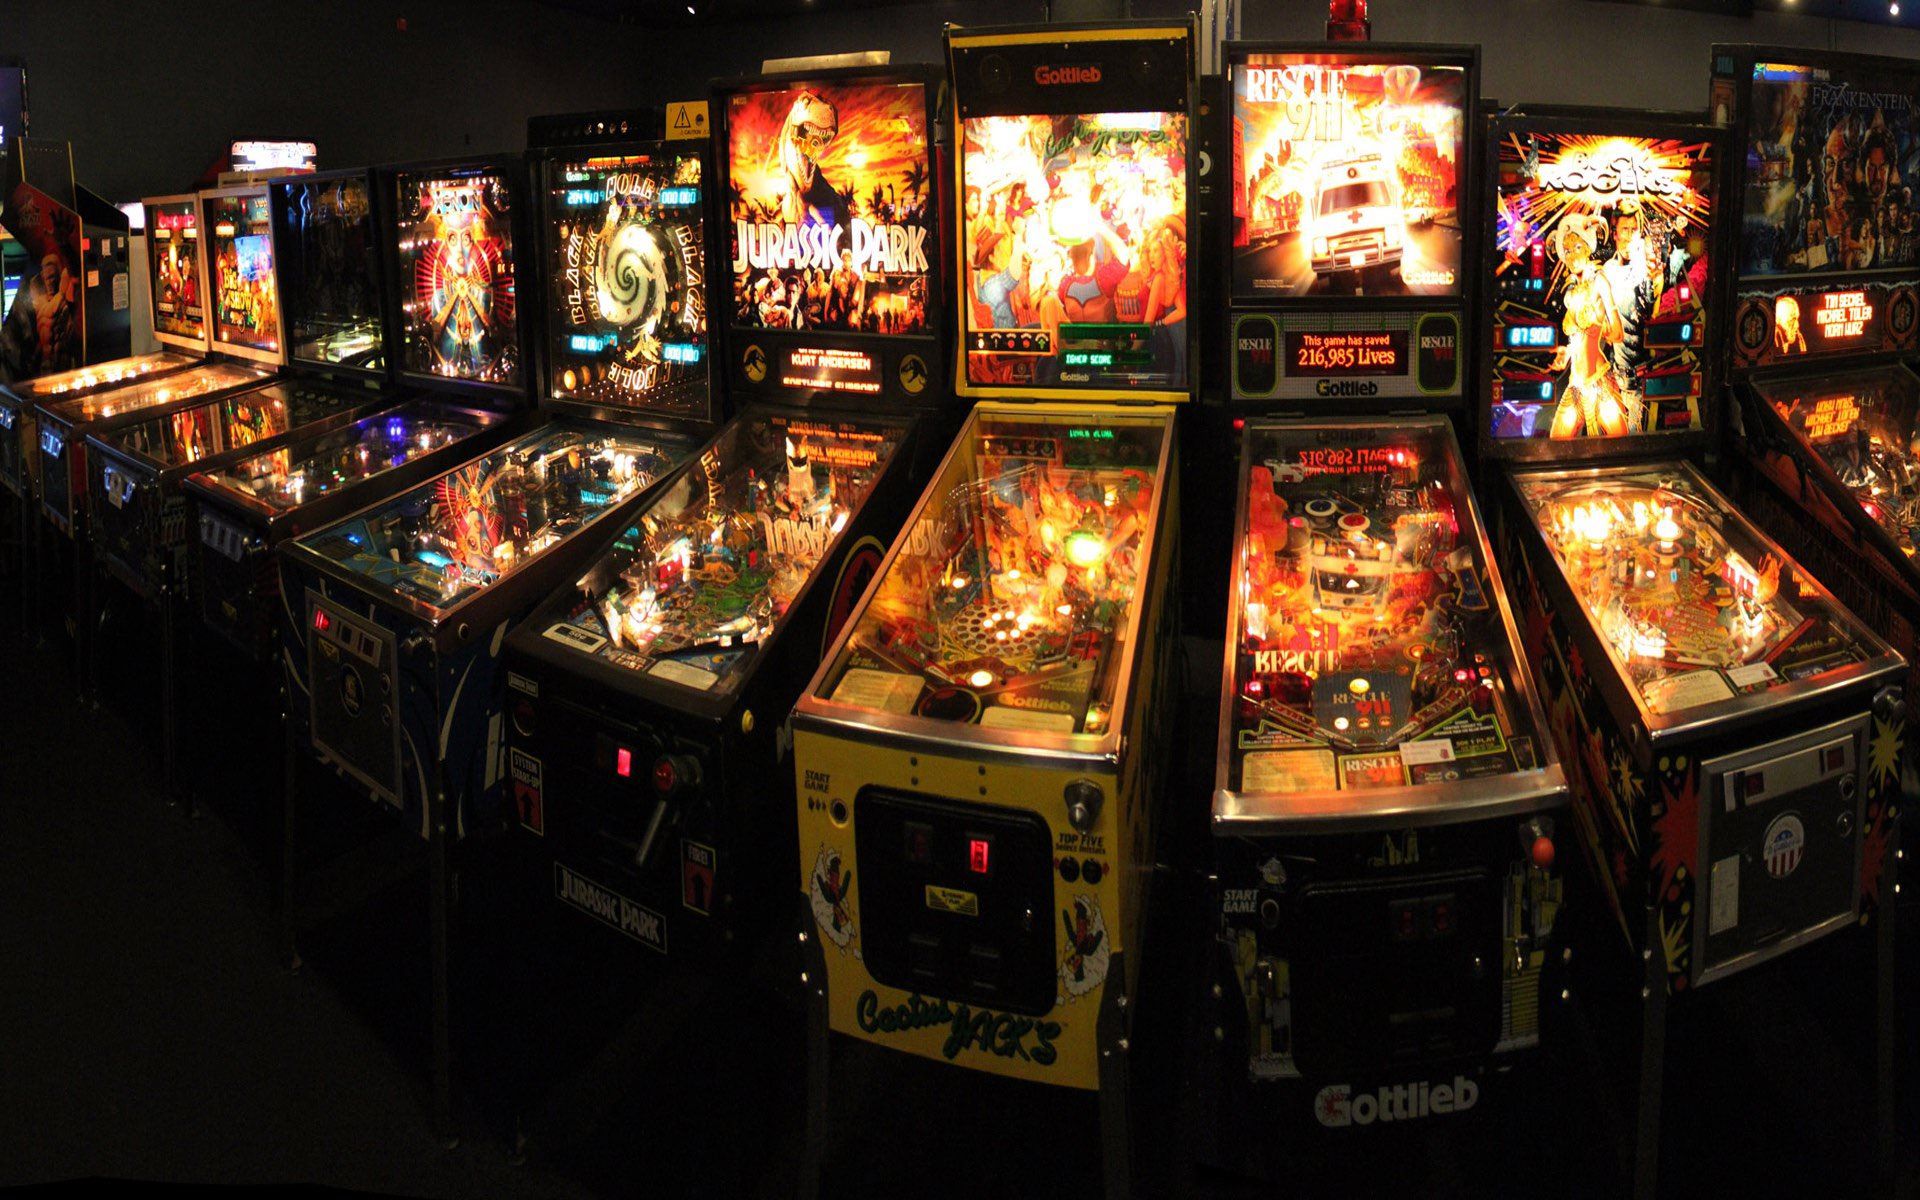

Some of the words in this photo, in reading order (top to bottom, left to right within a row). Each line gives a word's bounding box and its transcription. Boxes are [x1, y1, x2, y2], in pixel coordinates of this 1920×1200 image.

[1035, 65, 1102, 84] Gottlieb
[1245, 69, 1347, 102] RESCUE
[1812, 82, 1914, 112] FRANKENSTEIN
[1286, 100, 1342, 141] 911
[606, 174, 655, 201] HOLE
[432, 188, 482, 214] XENON
[733, 218, 844, 273] JURASSIC
[851, 218, 929, 281] PARK
[566, 225, 587, 326] BLACK
[674, 224, 702, 333] BLACK
[1238, 338, 1272, 350] RESCUE
[1303, 336, 1321, 346] This
[1323, 337, 1346, 349] game
[1347, 335, 1362, 346] has
[1364, 335, 1391, 346] saved
[1421, 336, 1455, 349] RESCUE
[791, 353, 816, 368] KURT
[818, 355, 871, 371] ANDERSEN
[1298, 348, 1355, 369] 216,985
[1358, 348, 1396, 365] Lives
[1060, 372, 1090, 383] Gottlieb
[1316, 378, 1379, 397] Gottlieb
[998, 691, 1072, 711] Gottlieb
[1345, 756, 1400, 772] RESCUE
[805, 769, 830, 783] START
[804, 780, 829, 793] GAME
[1059, 833, 1079, 844] TOP
[1081, 834, 1103, 848] FIVE
[1223, 888, 1260, 901] START
[560, 868, 620, 923] JURASSIC
[620, 900, 661, 944] PARK
[1222, 900, 1258, 913] GAME
[857, 988, 950, 1034] Cactus
[943, 1003, 1062, 1065] JACK'S
[1313, 1074, 1480, 1128] Gottlieb
